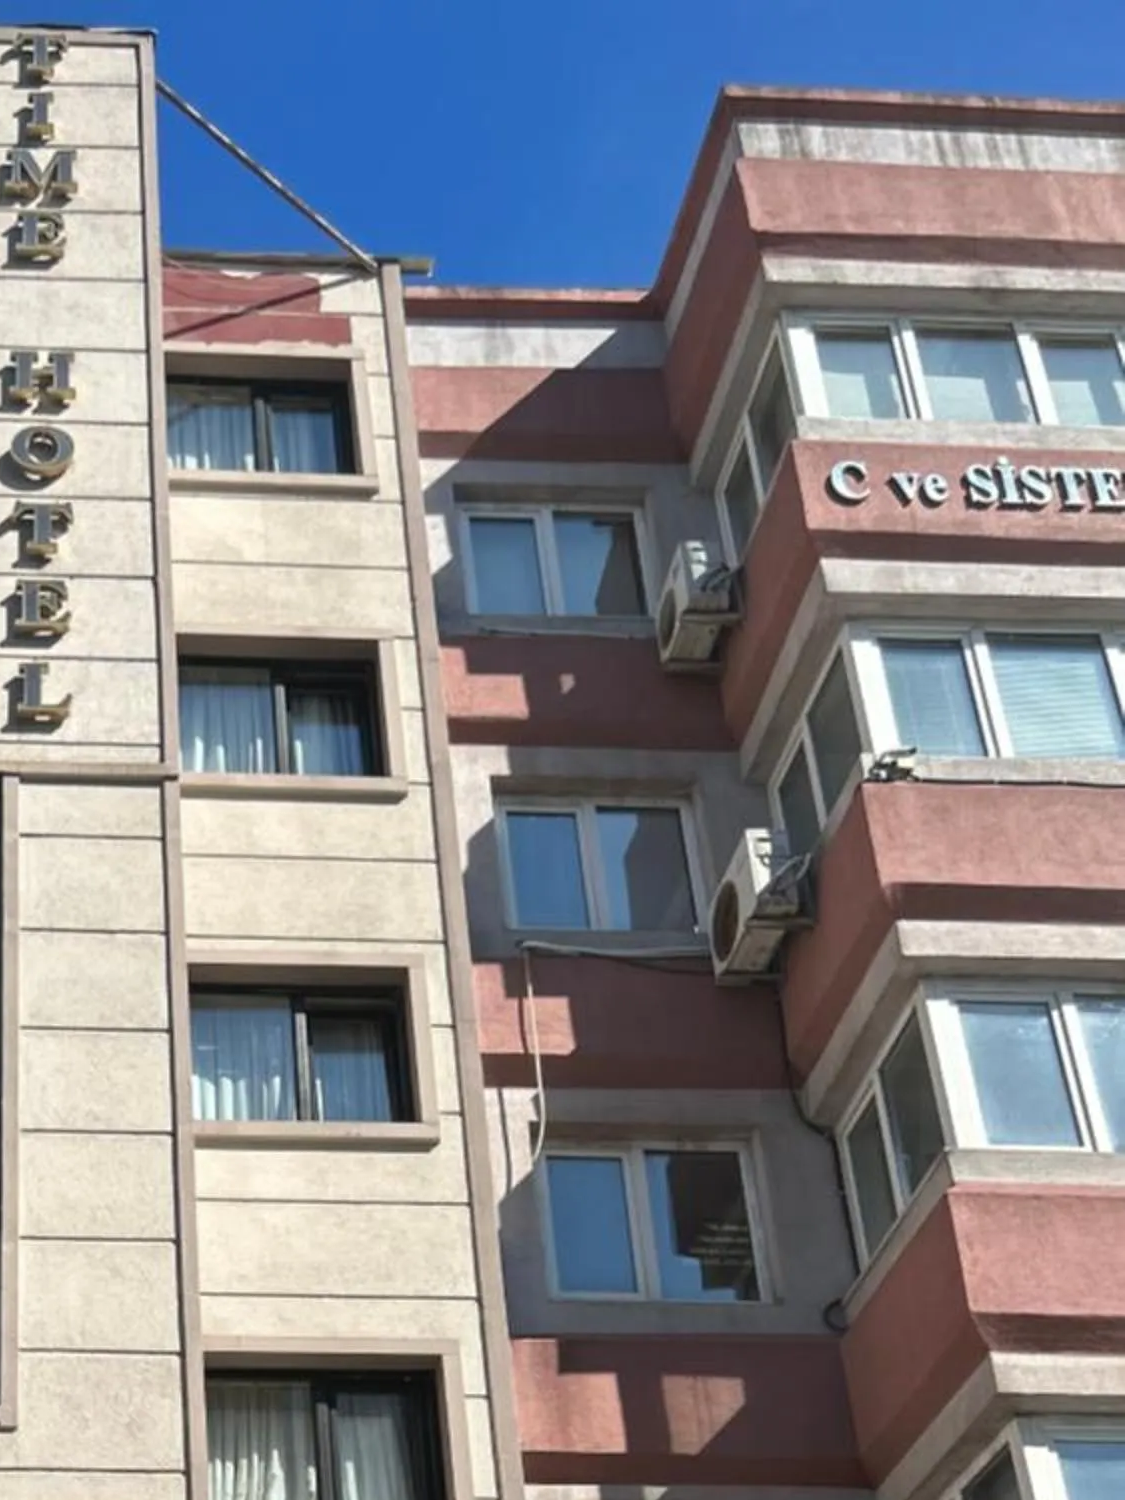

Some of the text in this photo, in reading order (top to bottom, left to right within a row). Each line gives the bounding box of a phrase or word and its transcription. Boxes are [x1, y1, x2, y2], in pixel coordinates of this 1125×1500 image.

[4, 32, 78, 724] TIME HOTEL
[828, 455, 1125, 507] C ve SİSTE
